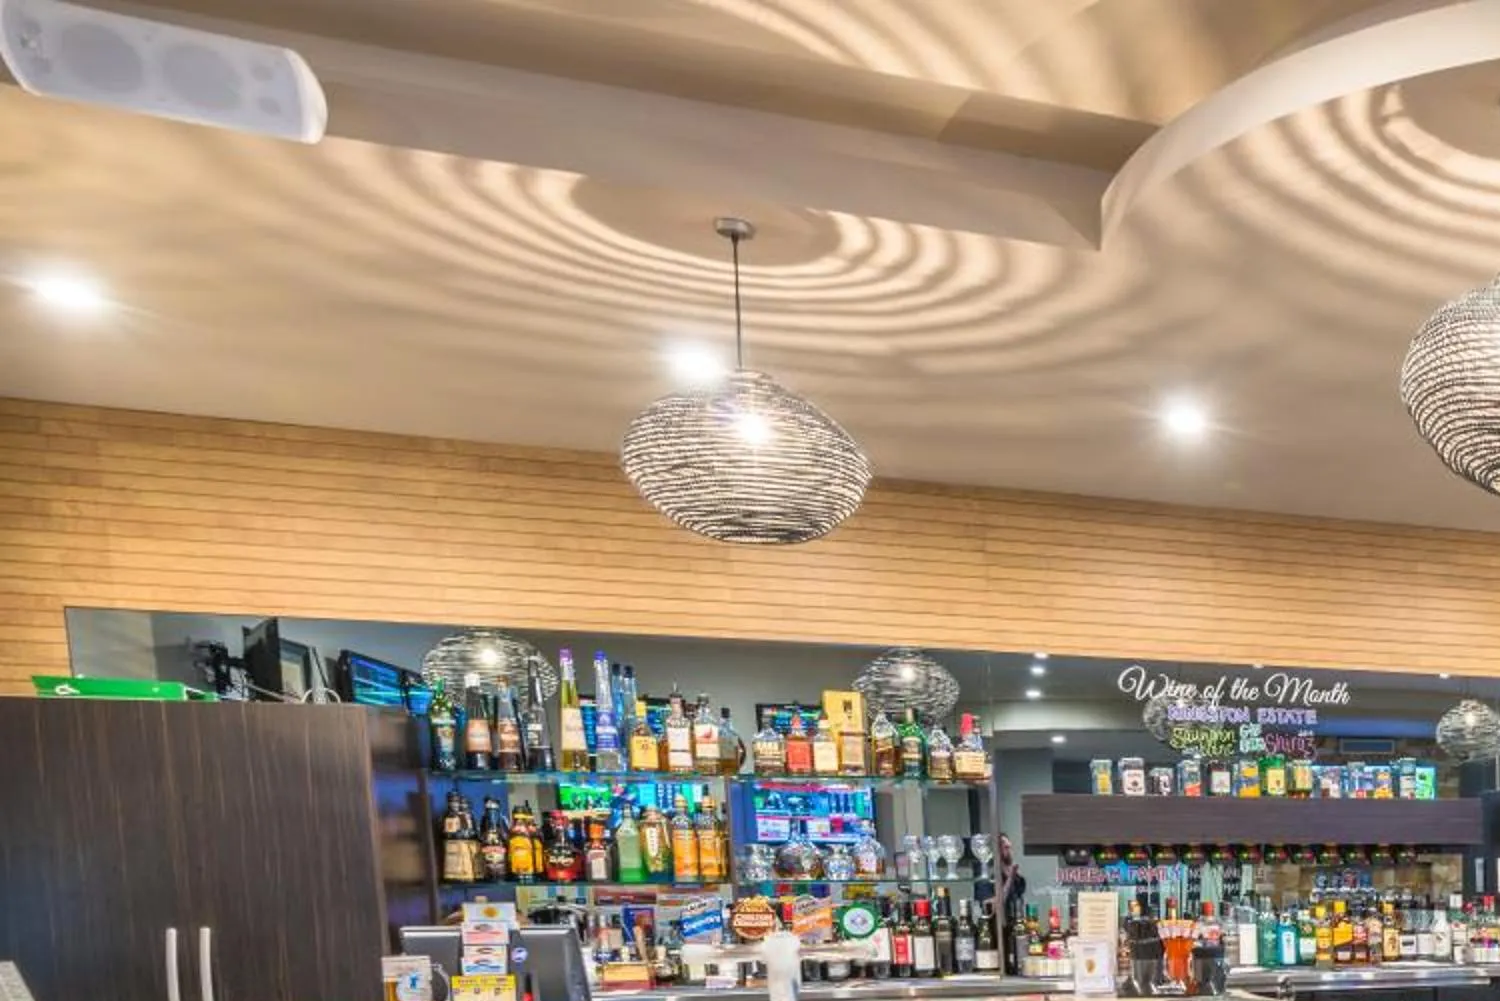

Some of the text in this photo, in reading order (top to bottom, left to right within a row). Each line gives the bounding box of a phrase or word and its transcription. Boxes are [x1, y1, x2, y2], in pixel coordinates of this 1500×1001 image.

[1117, 665, 1350, 709] Wine of the Month
